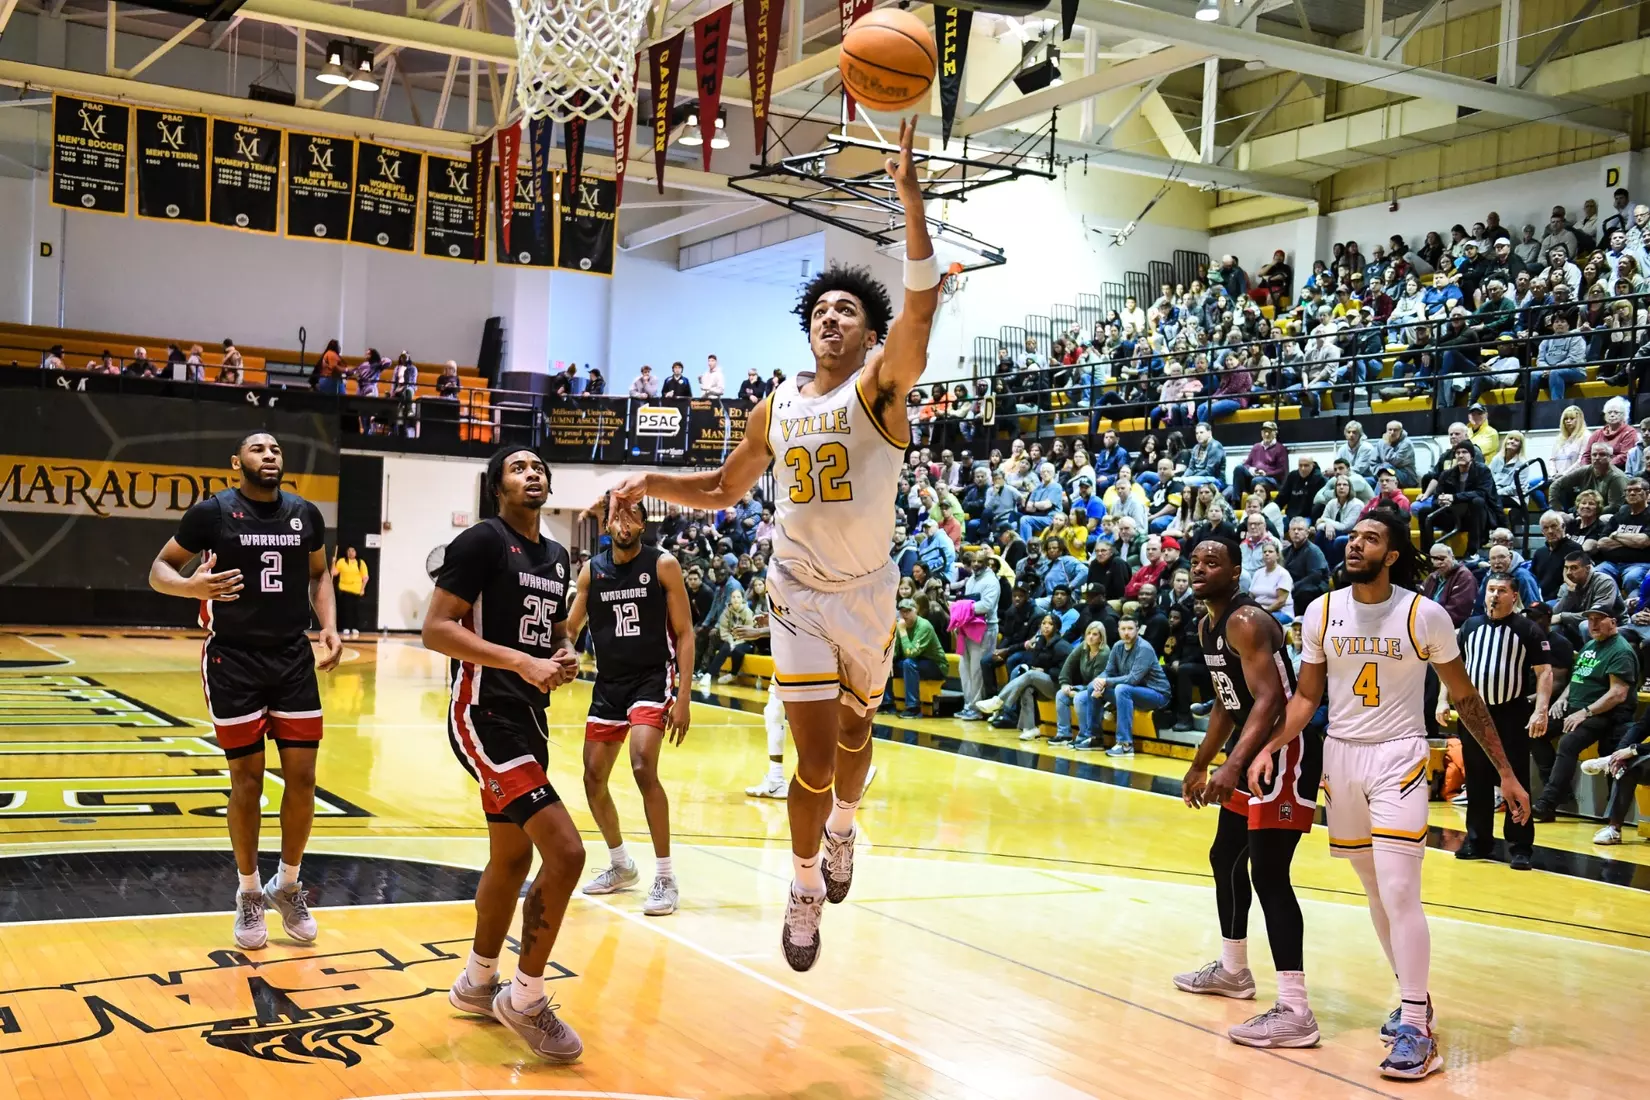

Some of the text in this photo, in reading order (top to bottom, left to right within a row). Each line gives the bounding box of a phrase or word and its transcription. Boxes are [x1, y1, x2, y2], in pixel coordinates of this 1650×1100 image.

[702, 17, 720, 96] IUP
[82, 102, 104, 111] PSAC
[656, 49, 670, 152] GANNON
[57, 134, 124, 152] MEN'S SOCCER
[214, 156, 250, 169] WOMEN'S
[327, 180, 348, 190] FIELD
[370, 179, 406, 193] WOMEN'S
[502, 135, 511, 227] CALIFORNIA
[1606, 168, 1620, 188] D
[393, 191, 415, 202] FIELD
[596, 211, 615, 220] GOLF
[40, 242, 52, 257] D
[639, 415, 678, 427] PSAC
[985, 398, 994, 423] D
[780, 406, 851, 442] VILLE
[784, 441, 853, 503] 32
[239, 534, 301, 546] WARRIORS
[260, 551, 283, 592] 2
[518, 571, 564, 597] WARRIORS
[600, 587, 648, 602] WARRIORS
[518, 594, 558, 648] 25
[612, 602, 641, 637] 12
[1331, 636, 1402, 660] VILLE
[1210, 671, 1241, 710] 23
[1352, 662, 1380, 707] 4
